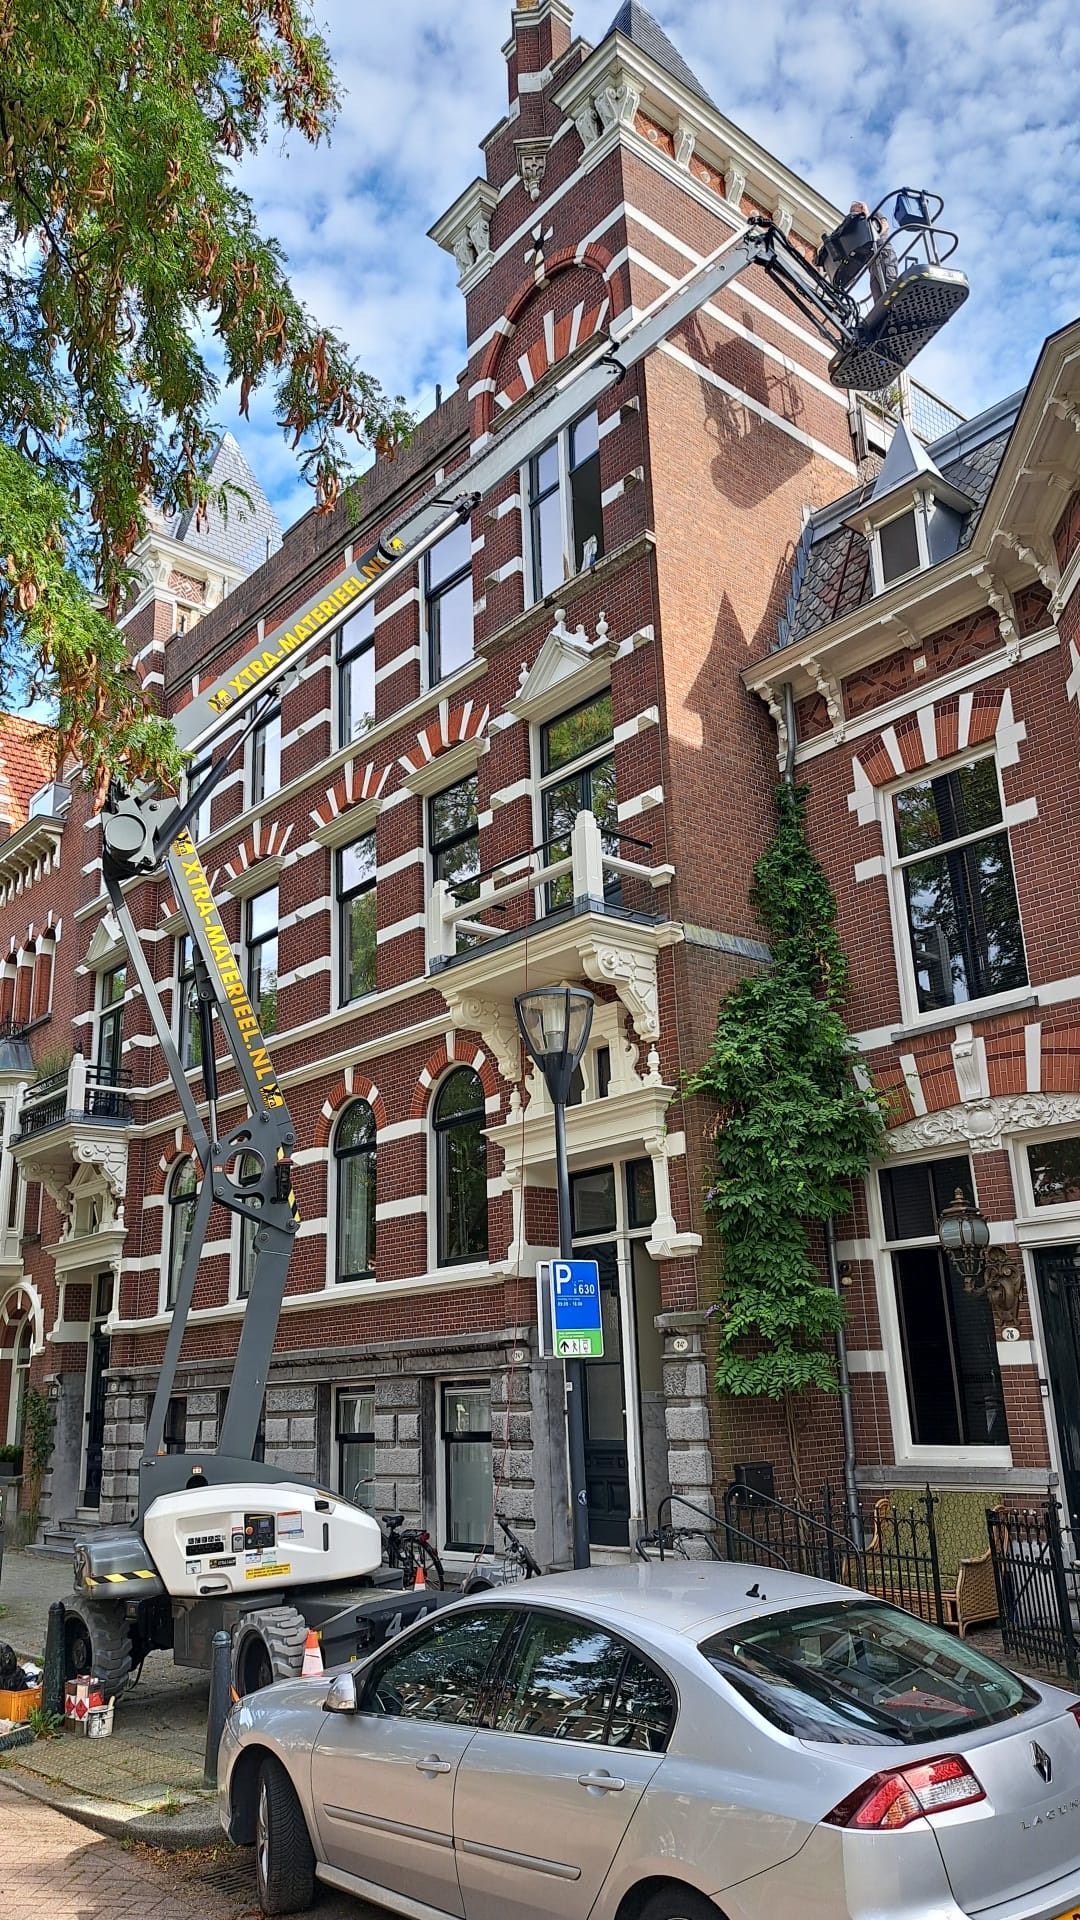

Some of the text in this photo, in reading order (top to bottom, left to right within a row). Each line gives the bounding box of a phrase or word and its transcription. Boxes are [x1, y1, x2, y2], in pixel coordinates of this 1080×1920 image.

[182, 859, 273, 1081] XTRA-MATERIEEL.NL
[555, 1264, 572, 1295] P
[578, 1284, 595, 1295] 630
